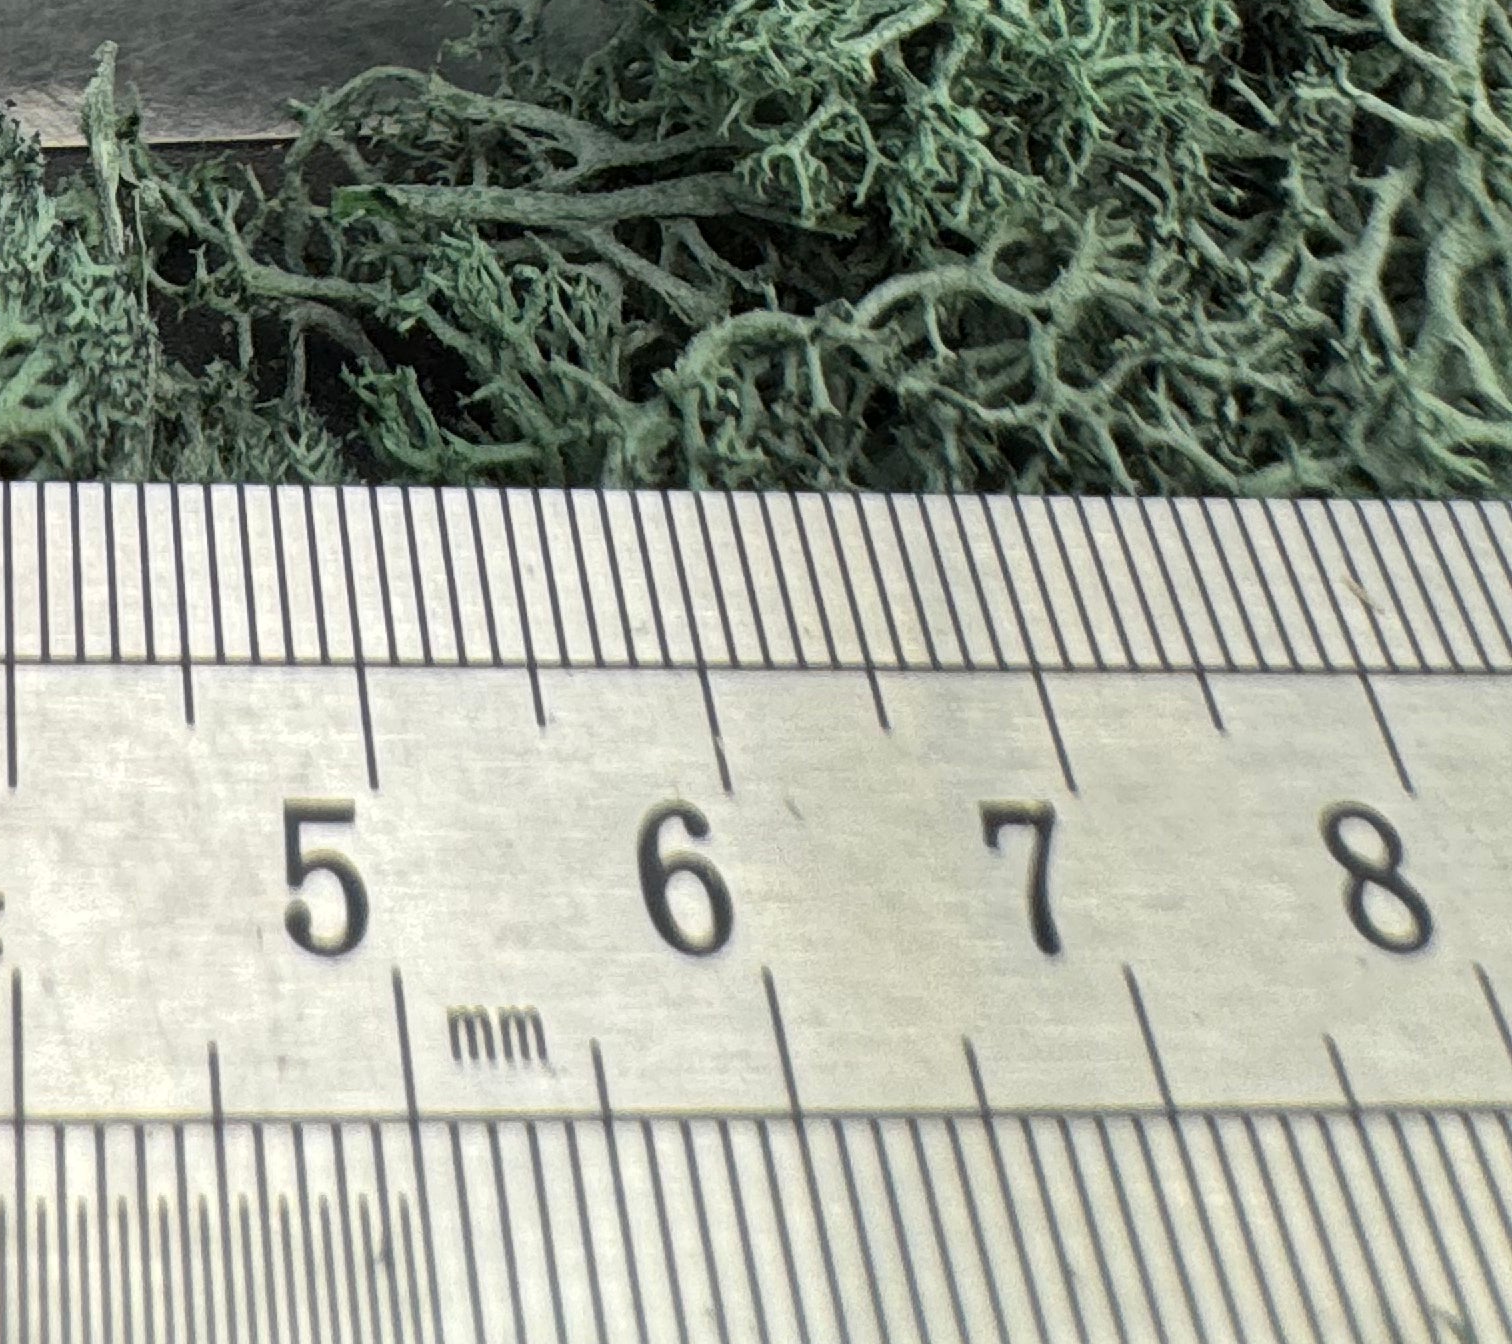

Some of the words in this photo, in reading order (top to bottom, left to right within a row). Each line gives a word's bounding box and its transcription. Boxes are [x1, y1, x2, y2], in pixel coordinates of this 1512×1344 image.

[282, 797, 370, 958] 5
[636, 797, 735, 958] 6
[977, 799, 1062, 956] 7
[1318, 799, 1435, 955] 8
[445, 1004, 549, 1065] mm
